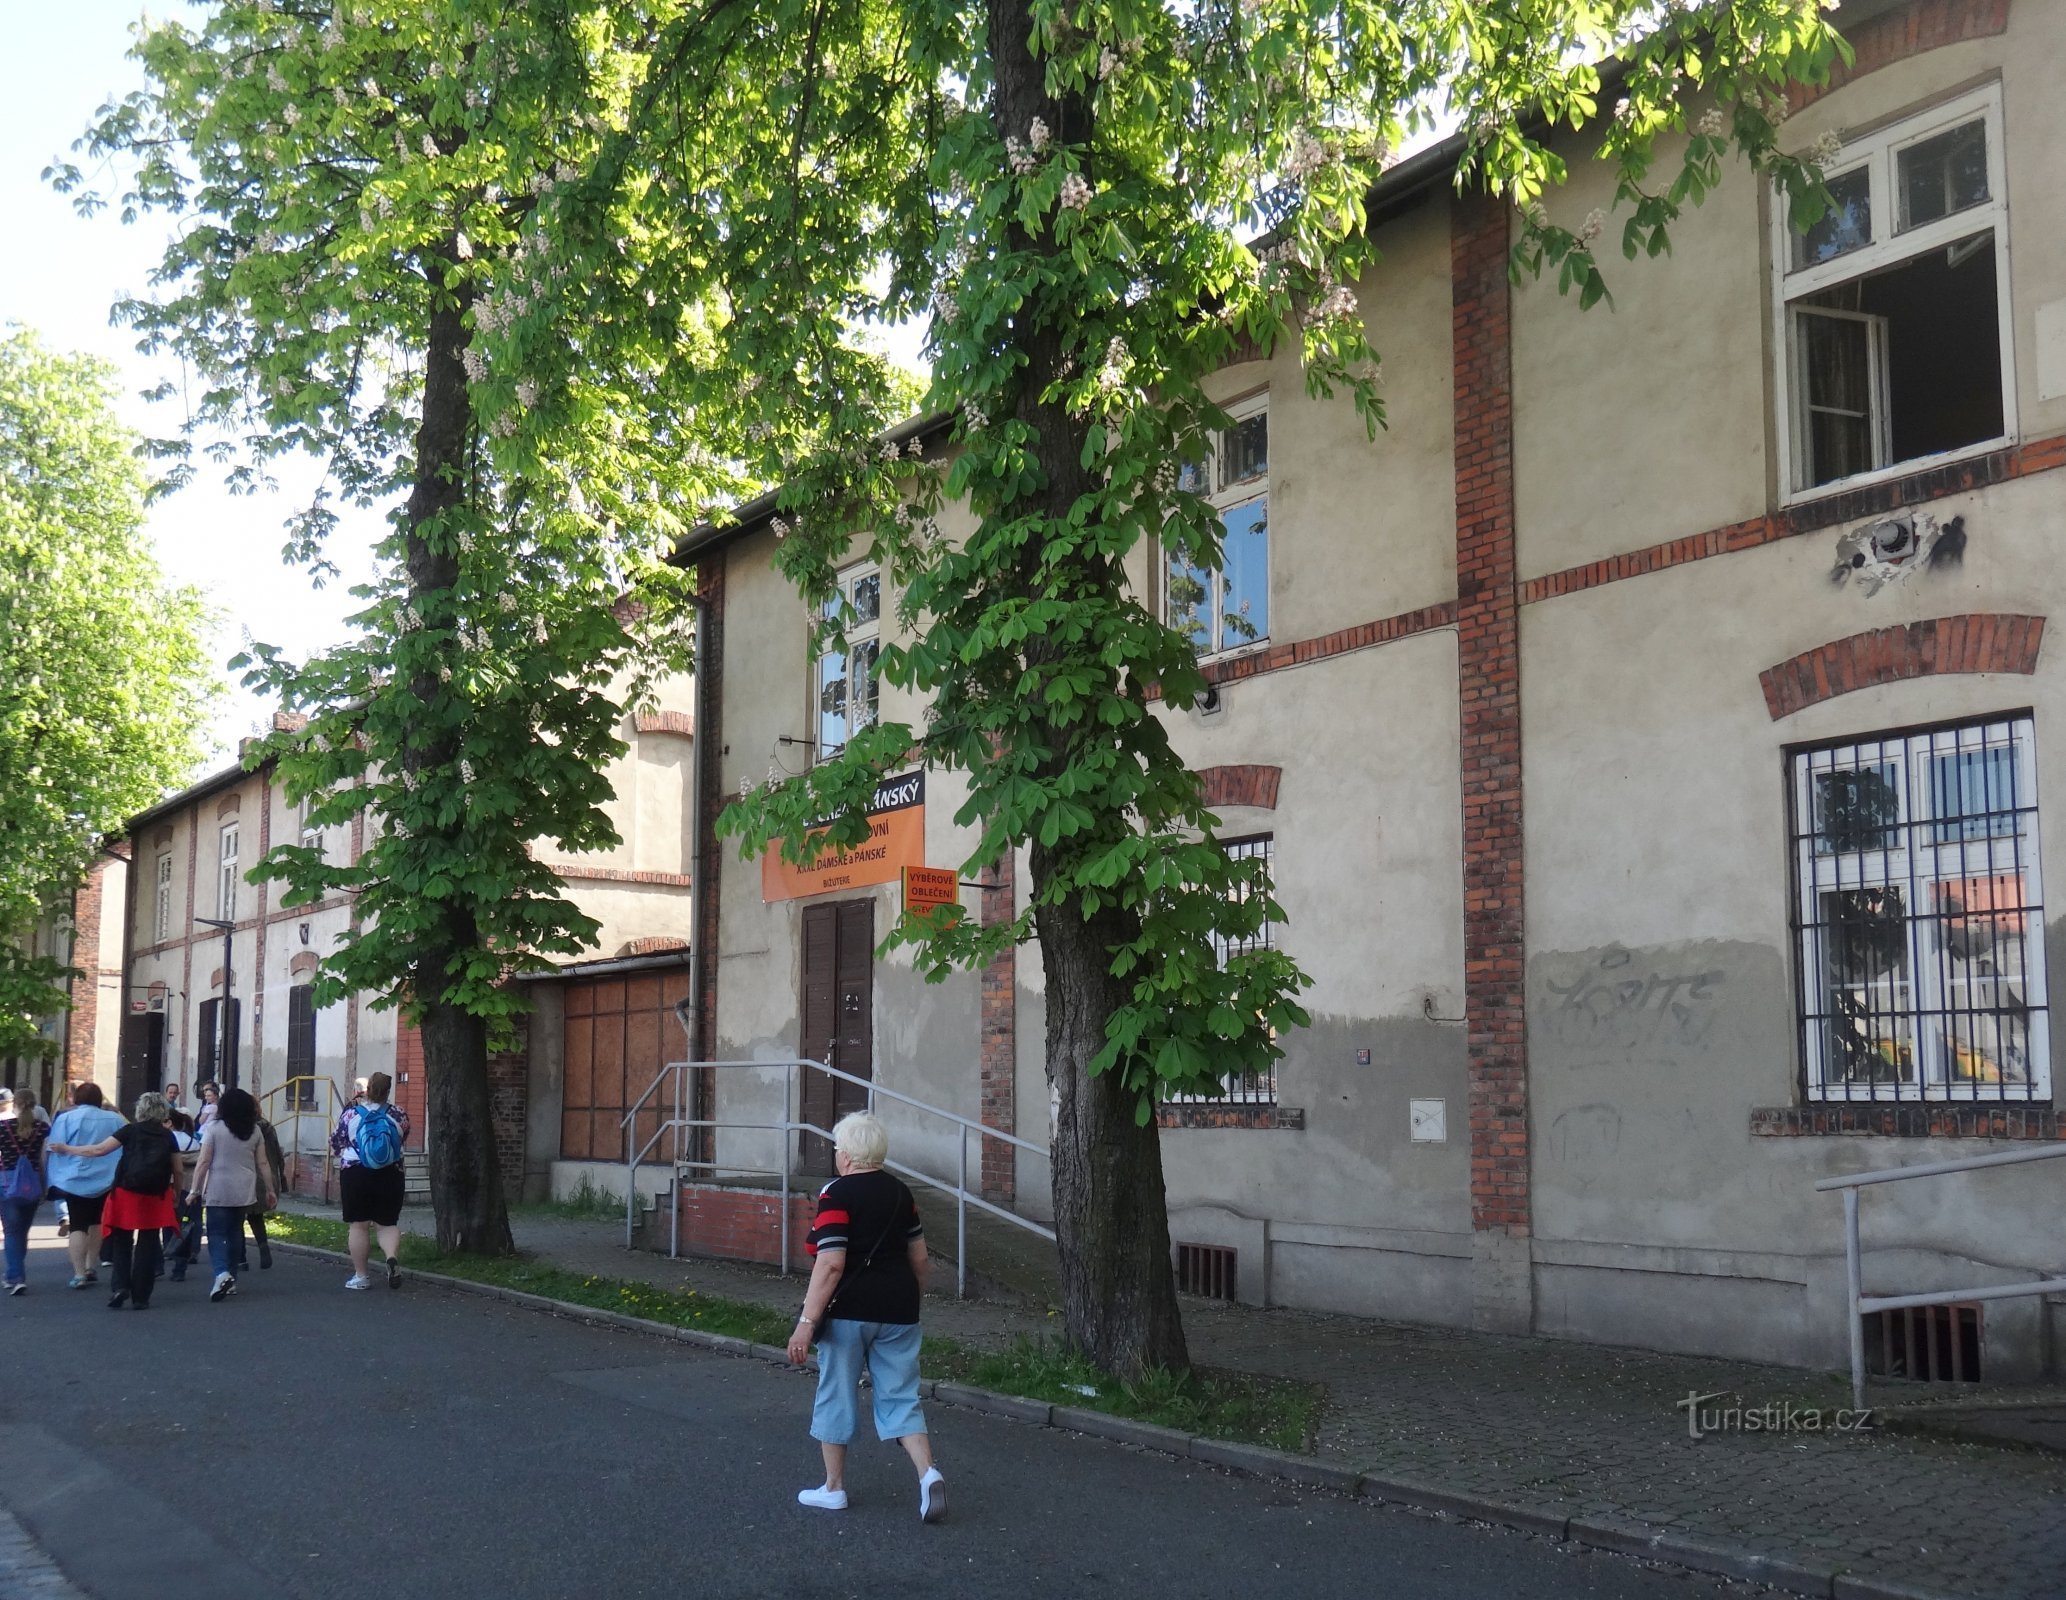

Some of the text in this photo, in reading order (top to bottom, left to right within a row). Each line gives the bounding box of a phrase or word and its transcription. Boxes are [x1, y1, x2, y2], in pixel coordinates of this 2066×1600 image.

[848, 856, 854, 865] a
[854, 844, 887, 863] PÁNSKÉ
[823, 875, 851, 888] BIŽUTERIE
[910, 872, 954, 885] VÝBĚROVÉ
[911, 886, 953, 899] OBLEČENÍ
